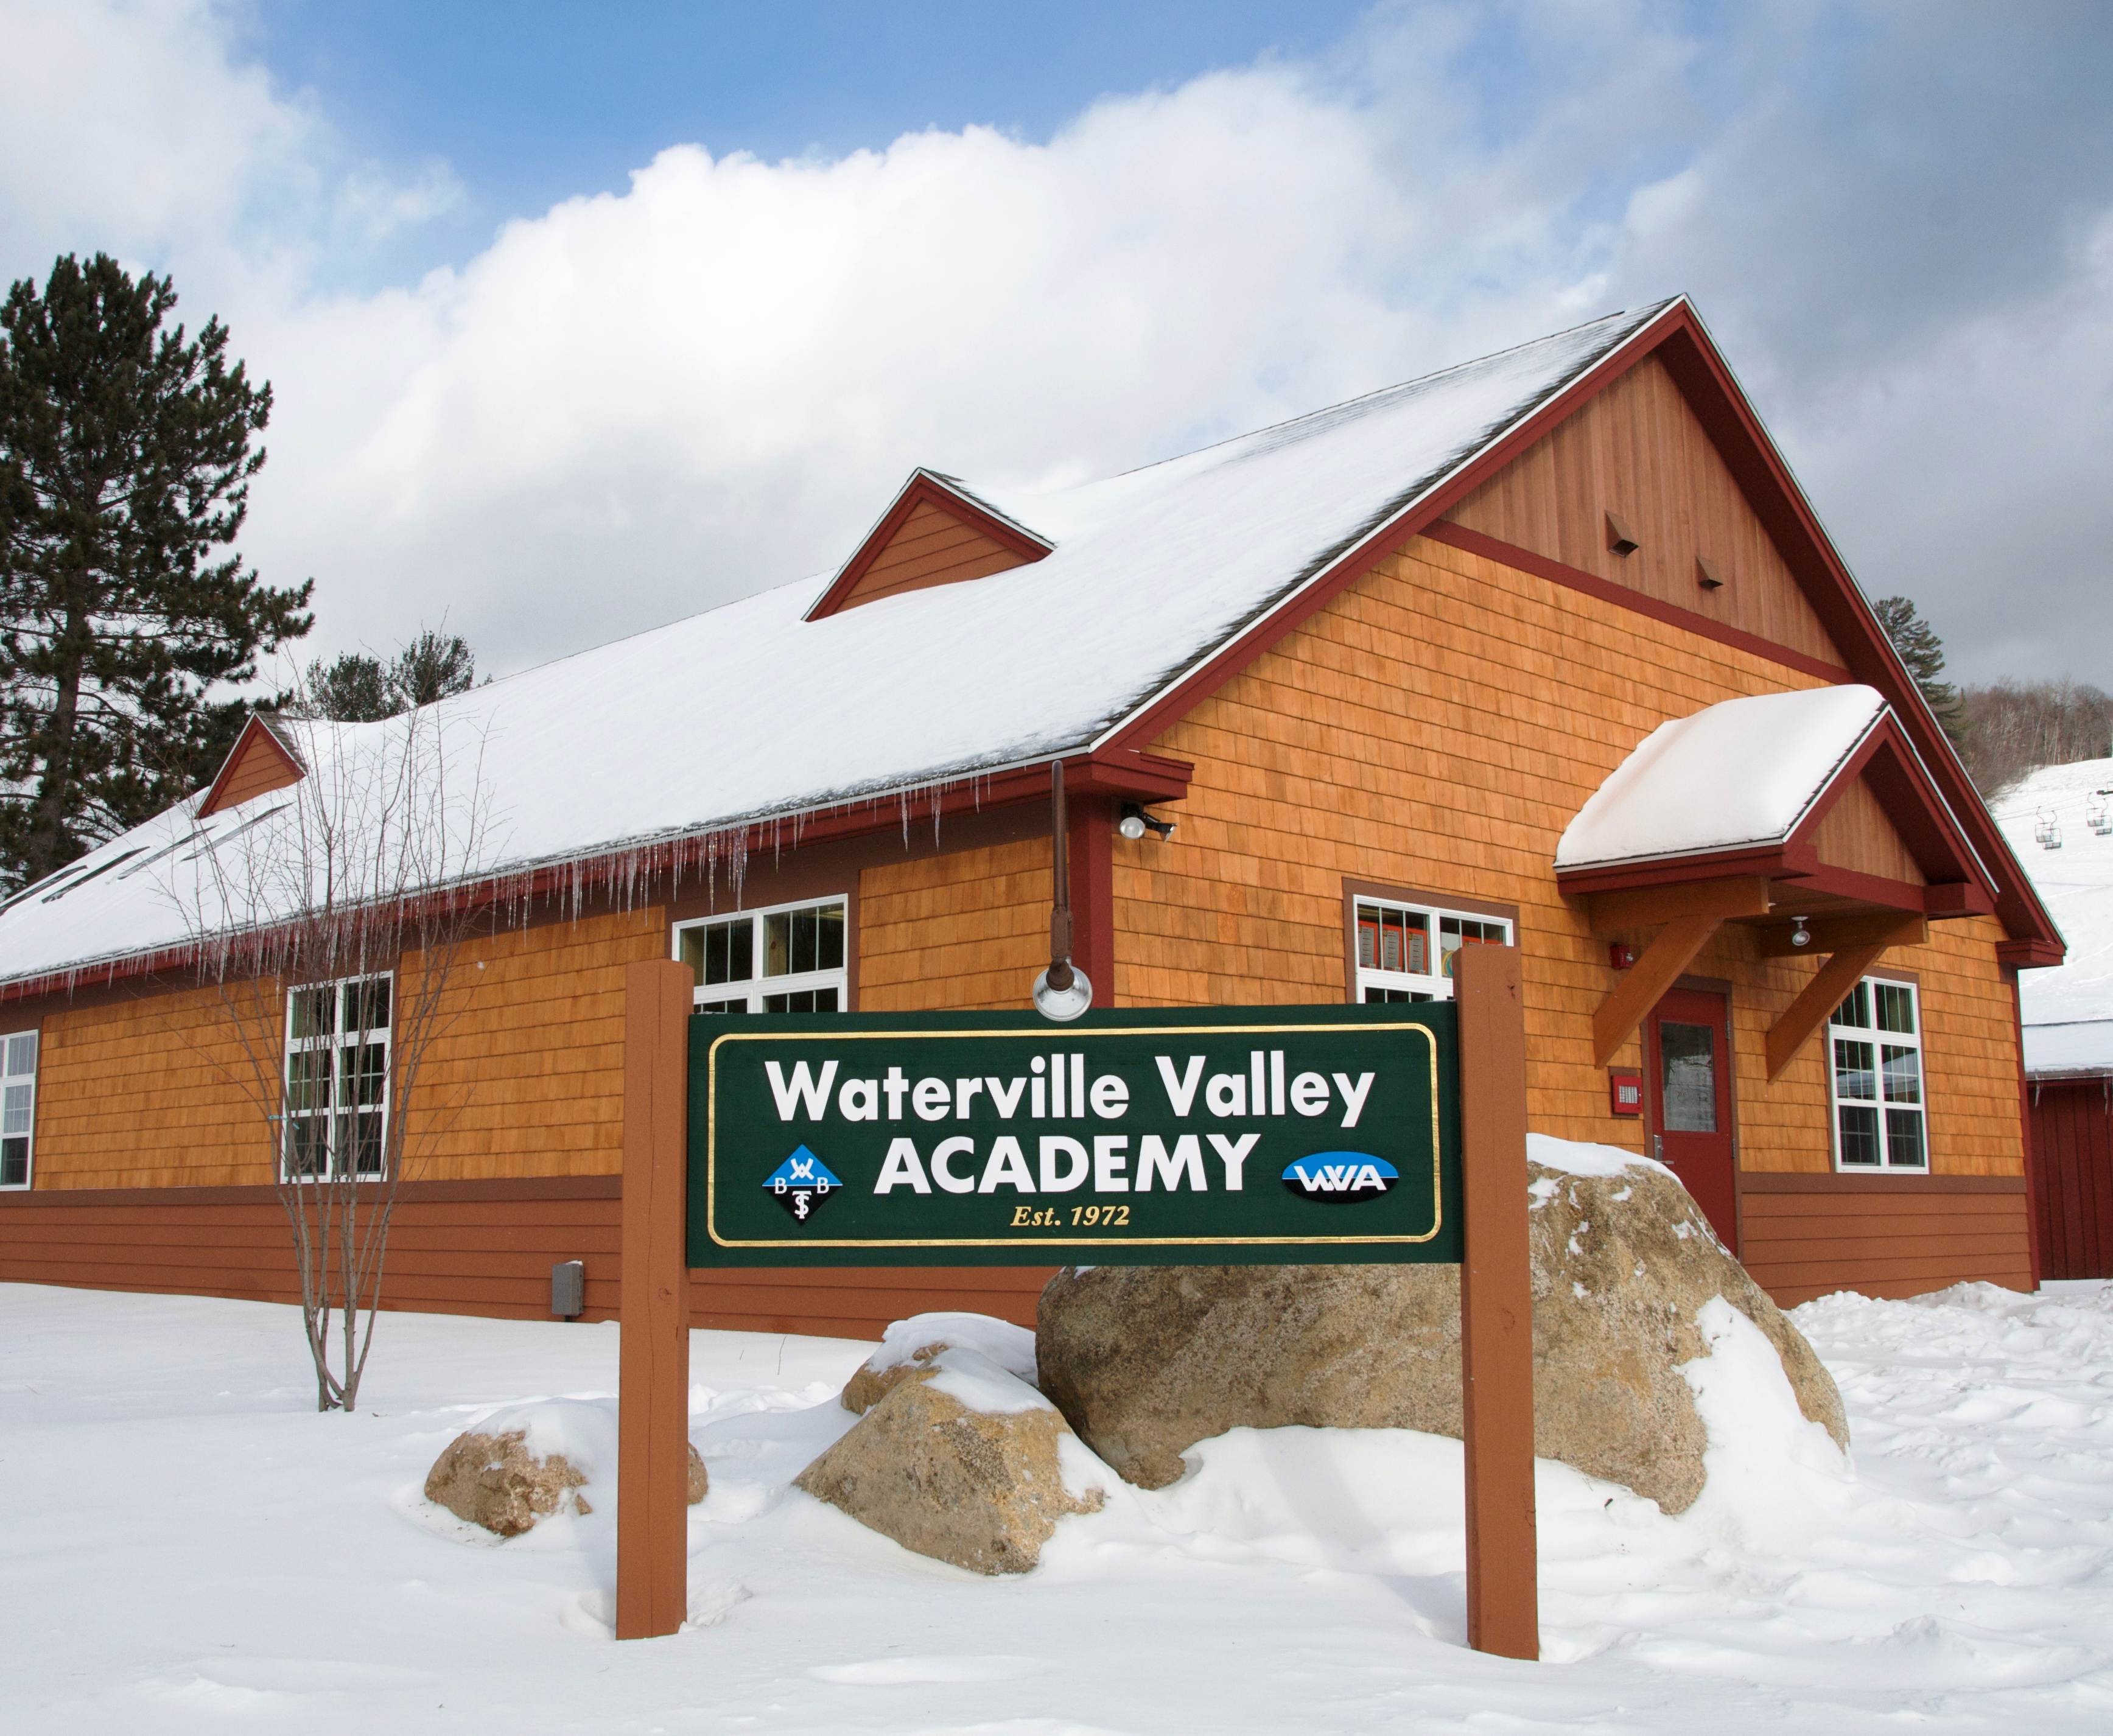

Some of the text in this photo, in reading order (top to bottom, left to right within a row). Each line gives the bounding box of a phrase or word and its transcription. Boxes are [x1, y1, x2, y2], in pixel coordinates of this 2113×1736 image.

[764, 1050, 1376, 1128] Waterville Valley
[873, 1133, 1261, 1194] ACADEMY
[1009, 1205, 1130, 1227] Est. 1972
